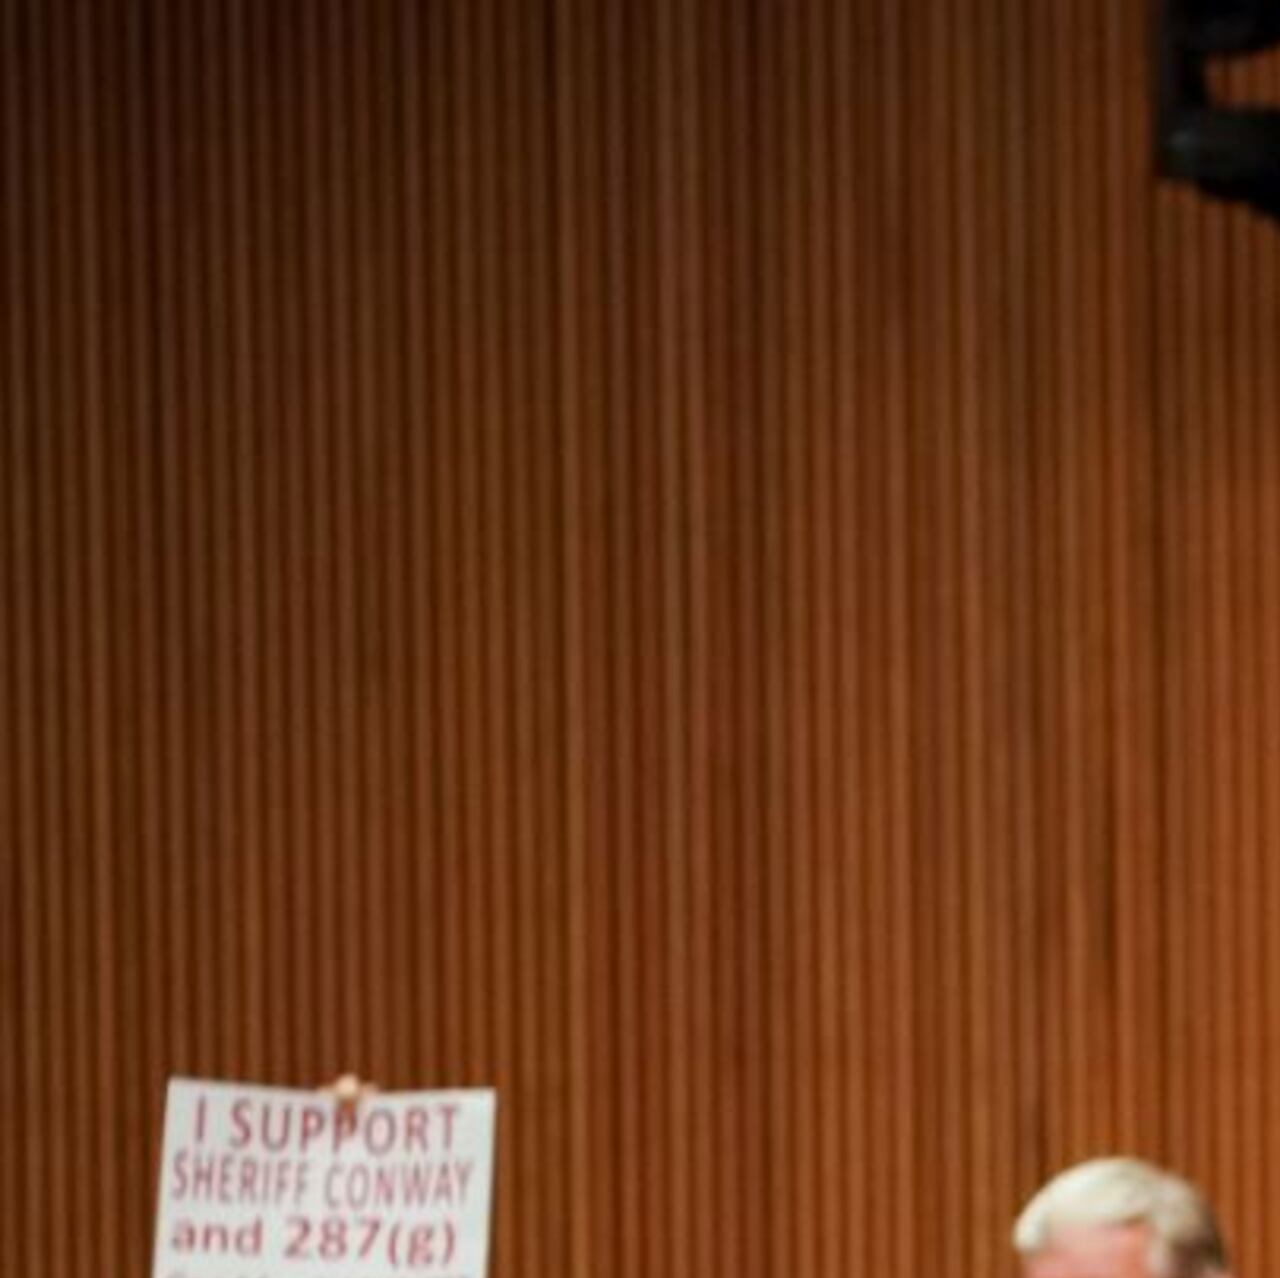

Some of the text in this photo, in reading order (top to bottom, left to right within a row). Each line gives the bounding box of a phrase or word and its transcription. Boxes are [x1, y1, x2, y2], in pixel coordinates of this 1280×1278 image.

[195, 1094, 461, 1156] I SUPPORT
[171, 1149, 475, 1209] SHERIFF CONWAY
[171, 1215, 458, 1269] and 287(g)
